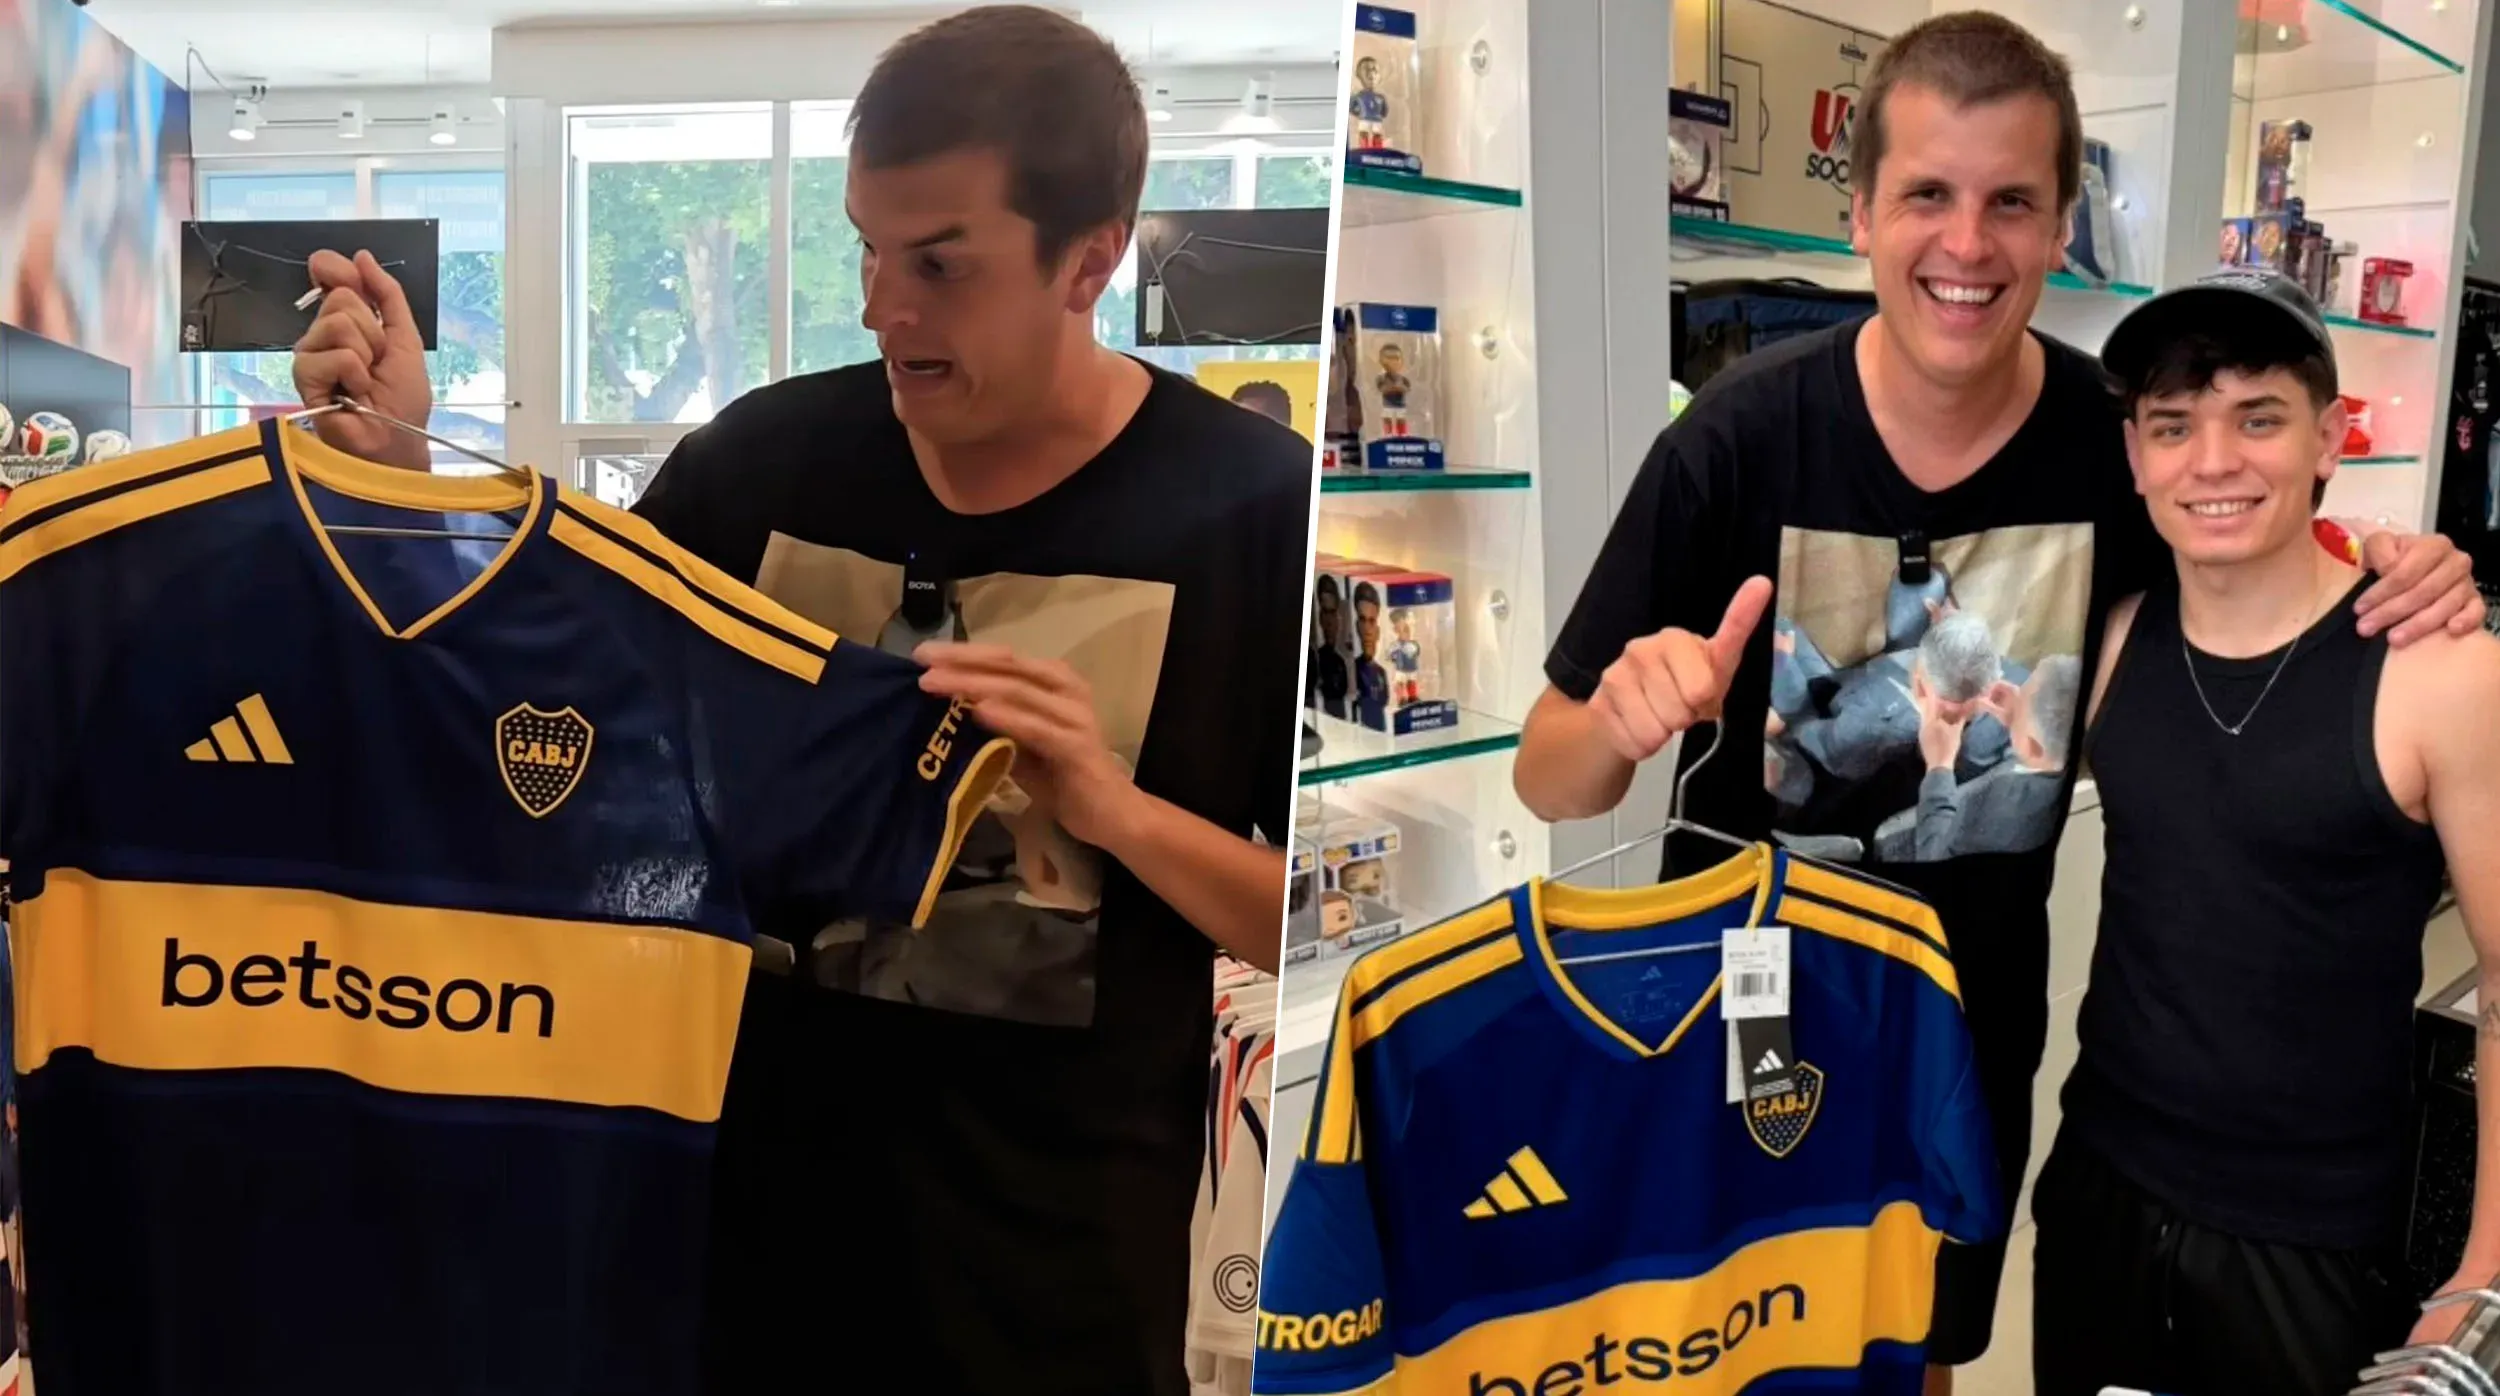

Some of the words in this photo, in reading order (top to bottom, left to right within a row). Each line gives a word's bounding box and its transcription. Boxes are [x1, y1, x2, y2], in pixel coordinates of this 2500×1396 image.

[508, 740, 577, 768] CABJ
[161, 937, 555, 1038] betsson
[1754, 1091, 1812, 1118] CABJ
[1257, 1297, 1383, 1351] TROGAR
